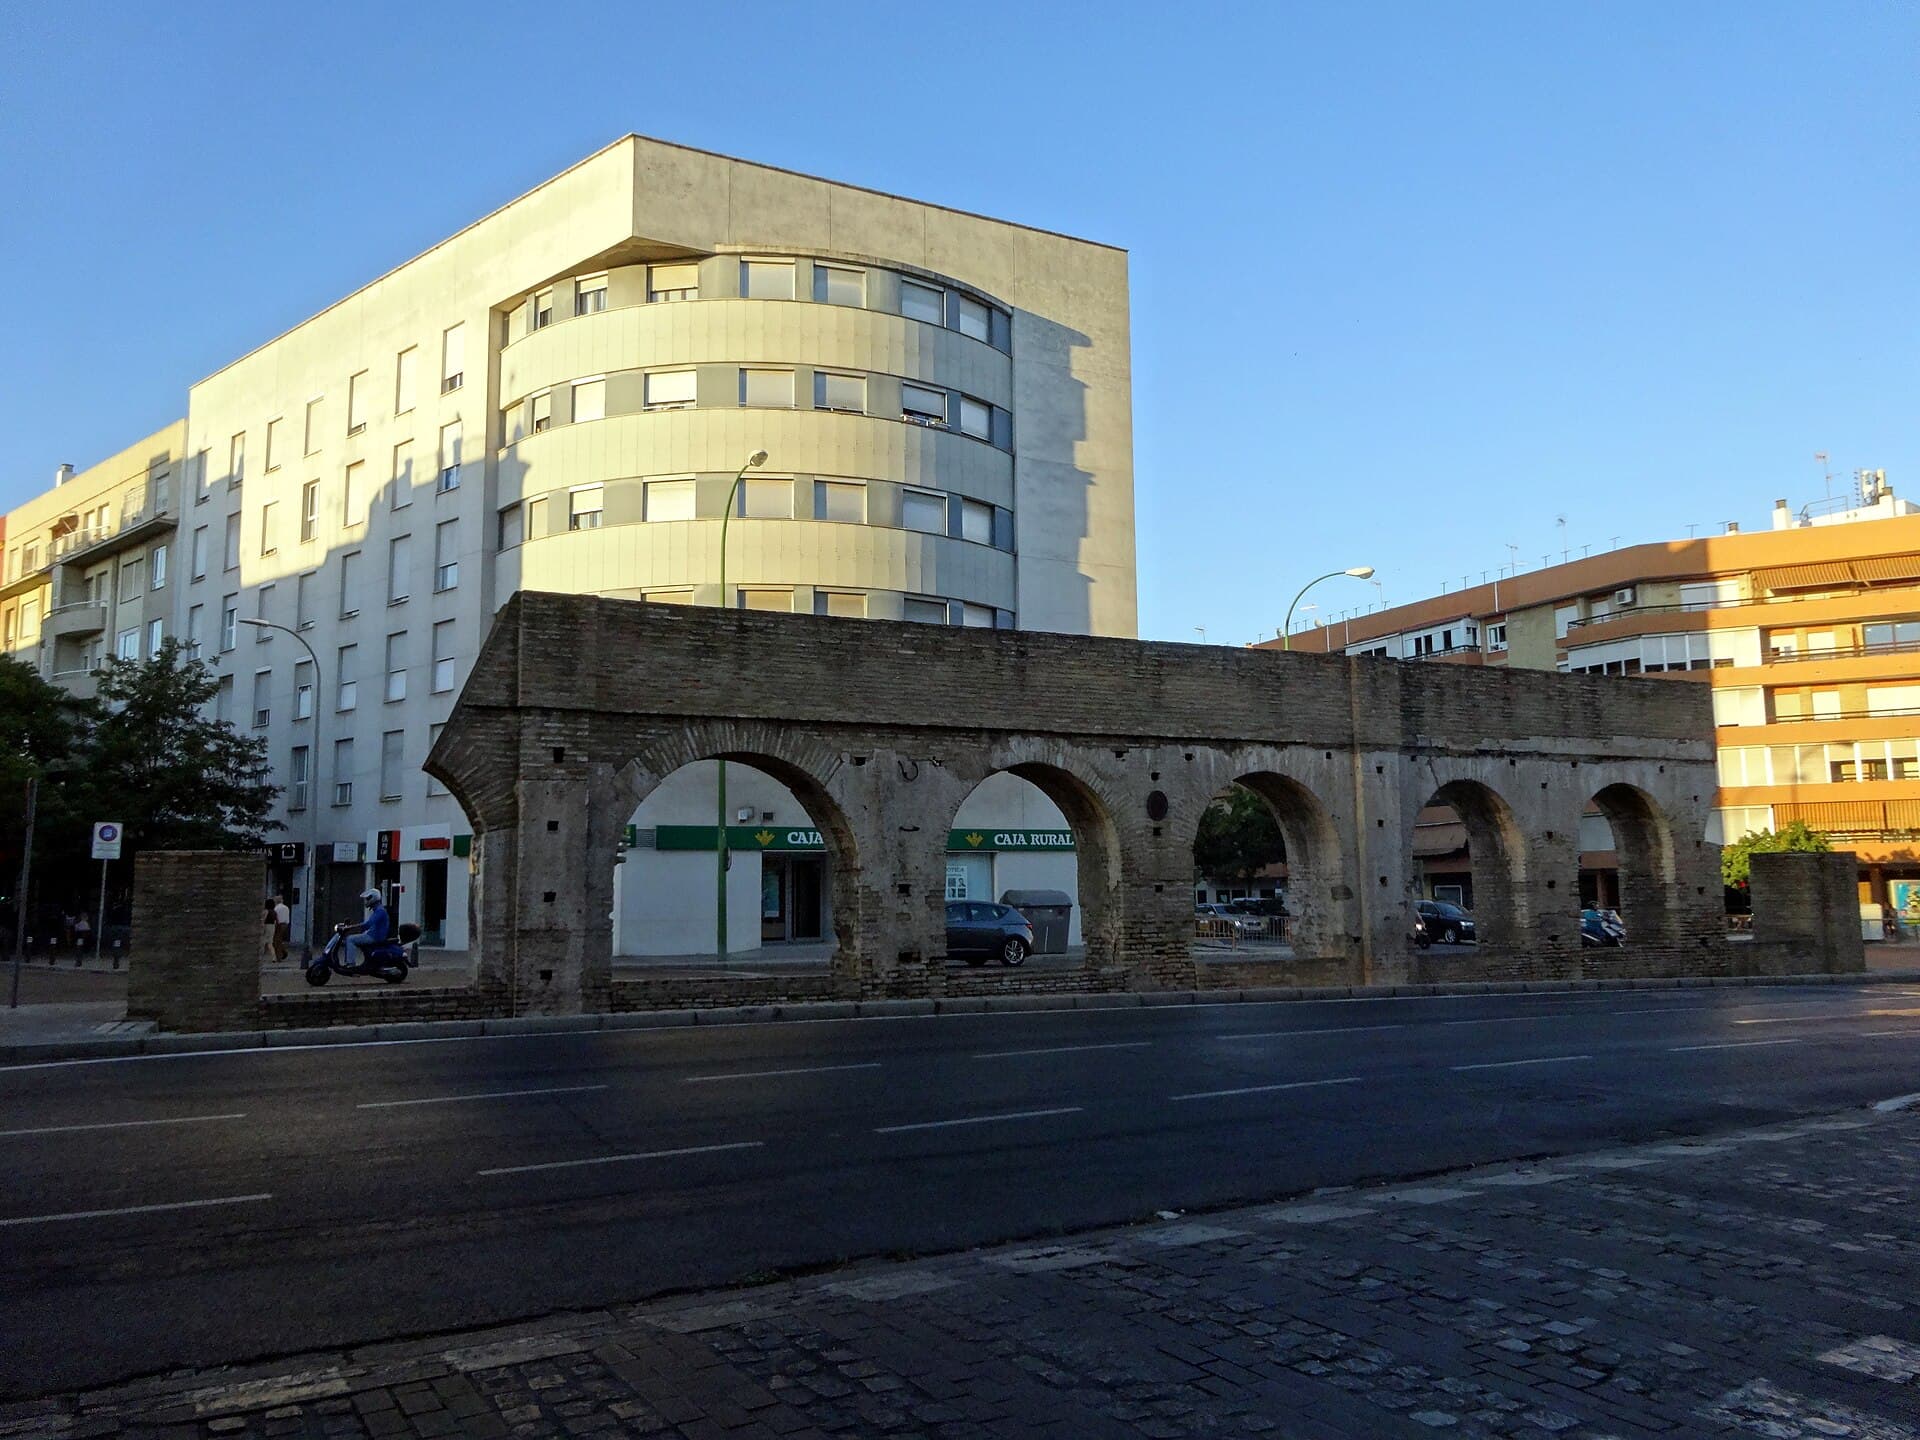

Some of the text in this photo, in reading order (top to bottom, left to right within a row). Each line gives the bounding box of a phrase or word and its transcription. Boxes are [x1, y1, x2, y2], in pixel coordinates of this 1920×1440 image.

[787, 831, 825, 845] CAJA
[994, 833, 1075, 846] CAJA RURAL
